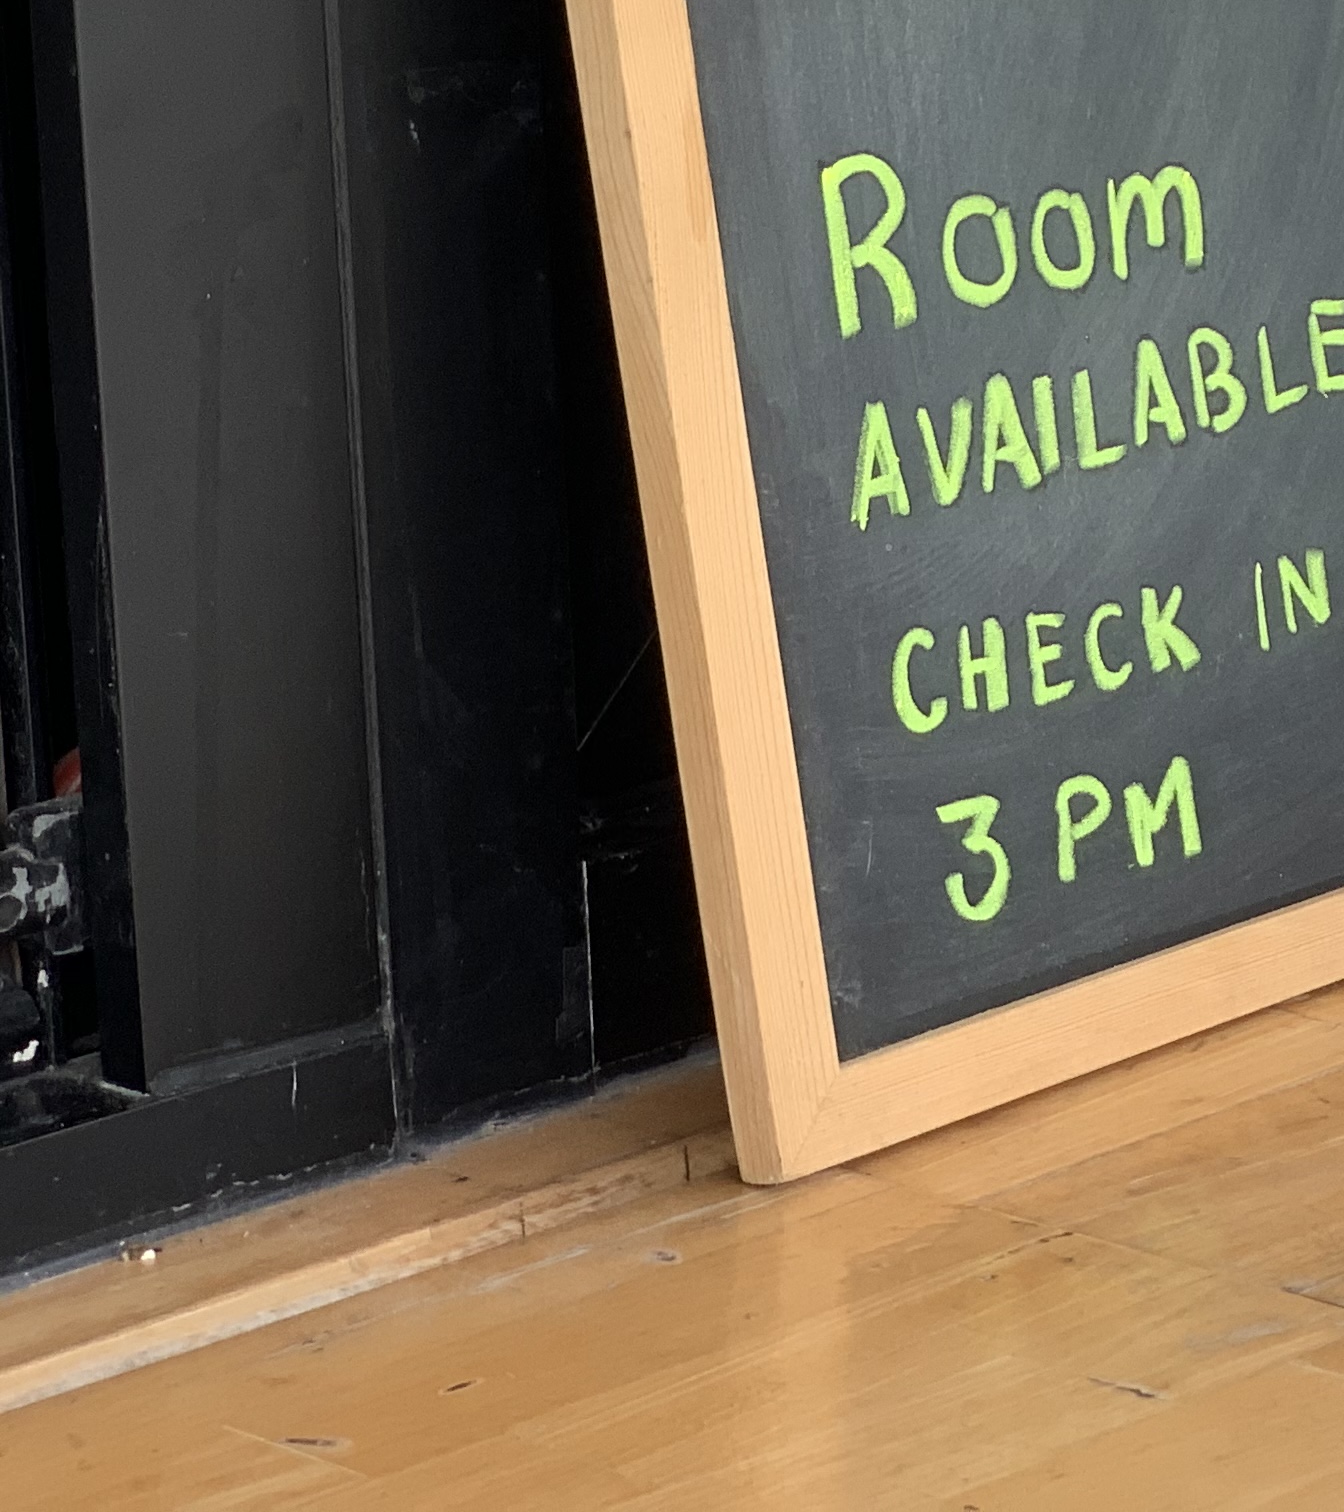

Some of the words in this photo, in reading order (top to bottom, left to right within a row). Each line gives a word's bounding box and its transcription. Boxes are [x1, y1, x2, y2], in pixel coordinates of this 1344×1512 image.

[892, 586, 1200, 734] CHECK
[1255, 548, 1331, 650] IN
[935, 795, 1011, 921] 3
[1055, 756, 1202, 882] PM
